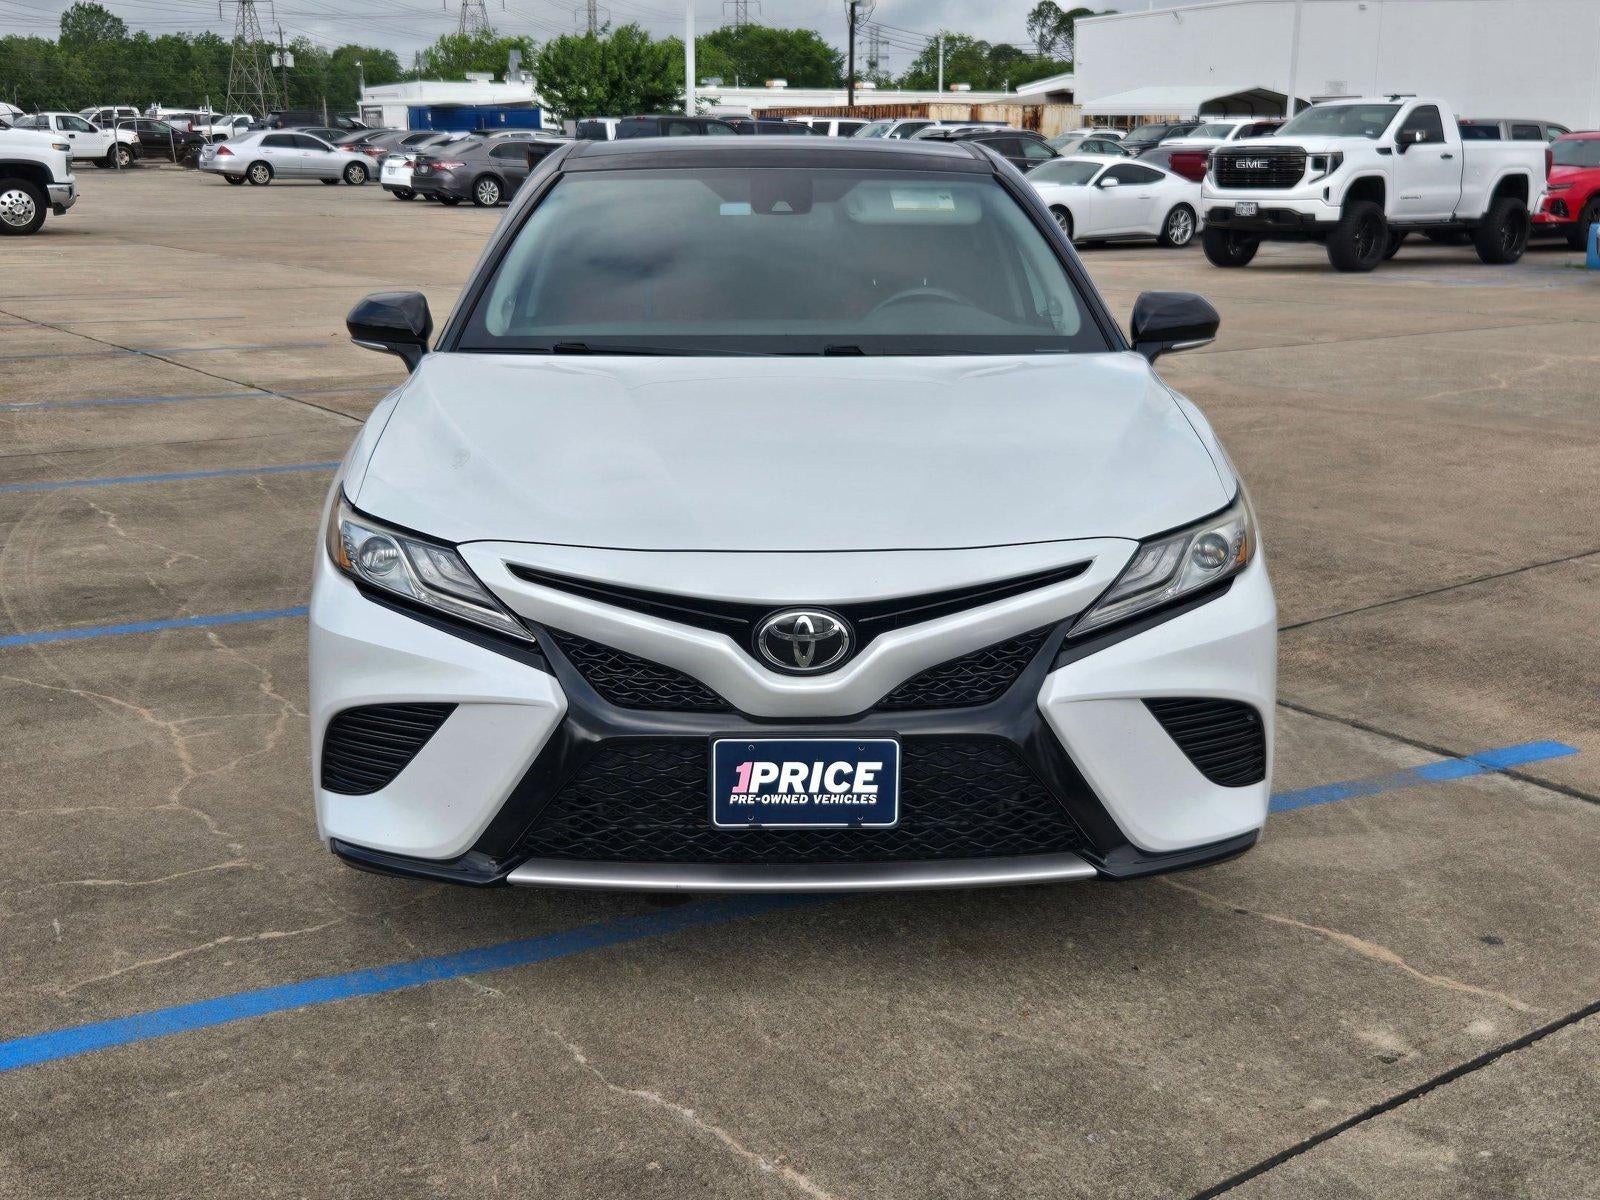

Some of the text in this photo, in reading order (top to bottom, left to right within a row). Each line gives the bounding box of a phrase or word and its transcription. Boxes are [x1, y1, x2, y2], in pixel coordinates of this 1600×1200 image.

[1235, 160, 1269, 169] GMC
[731, 761, 883, 793] 1PRICE
[729, 794, 878, 805] PRE-OWNED VEHICLES
